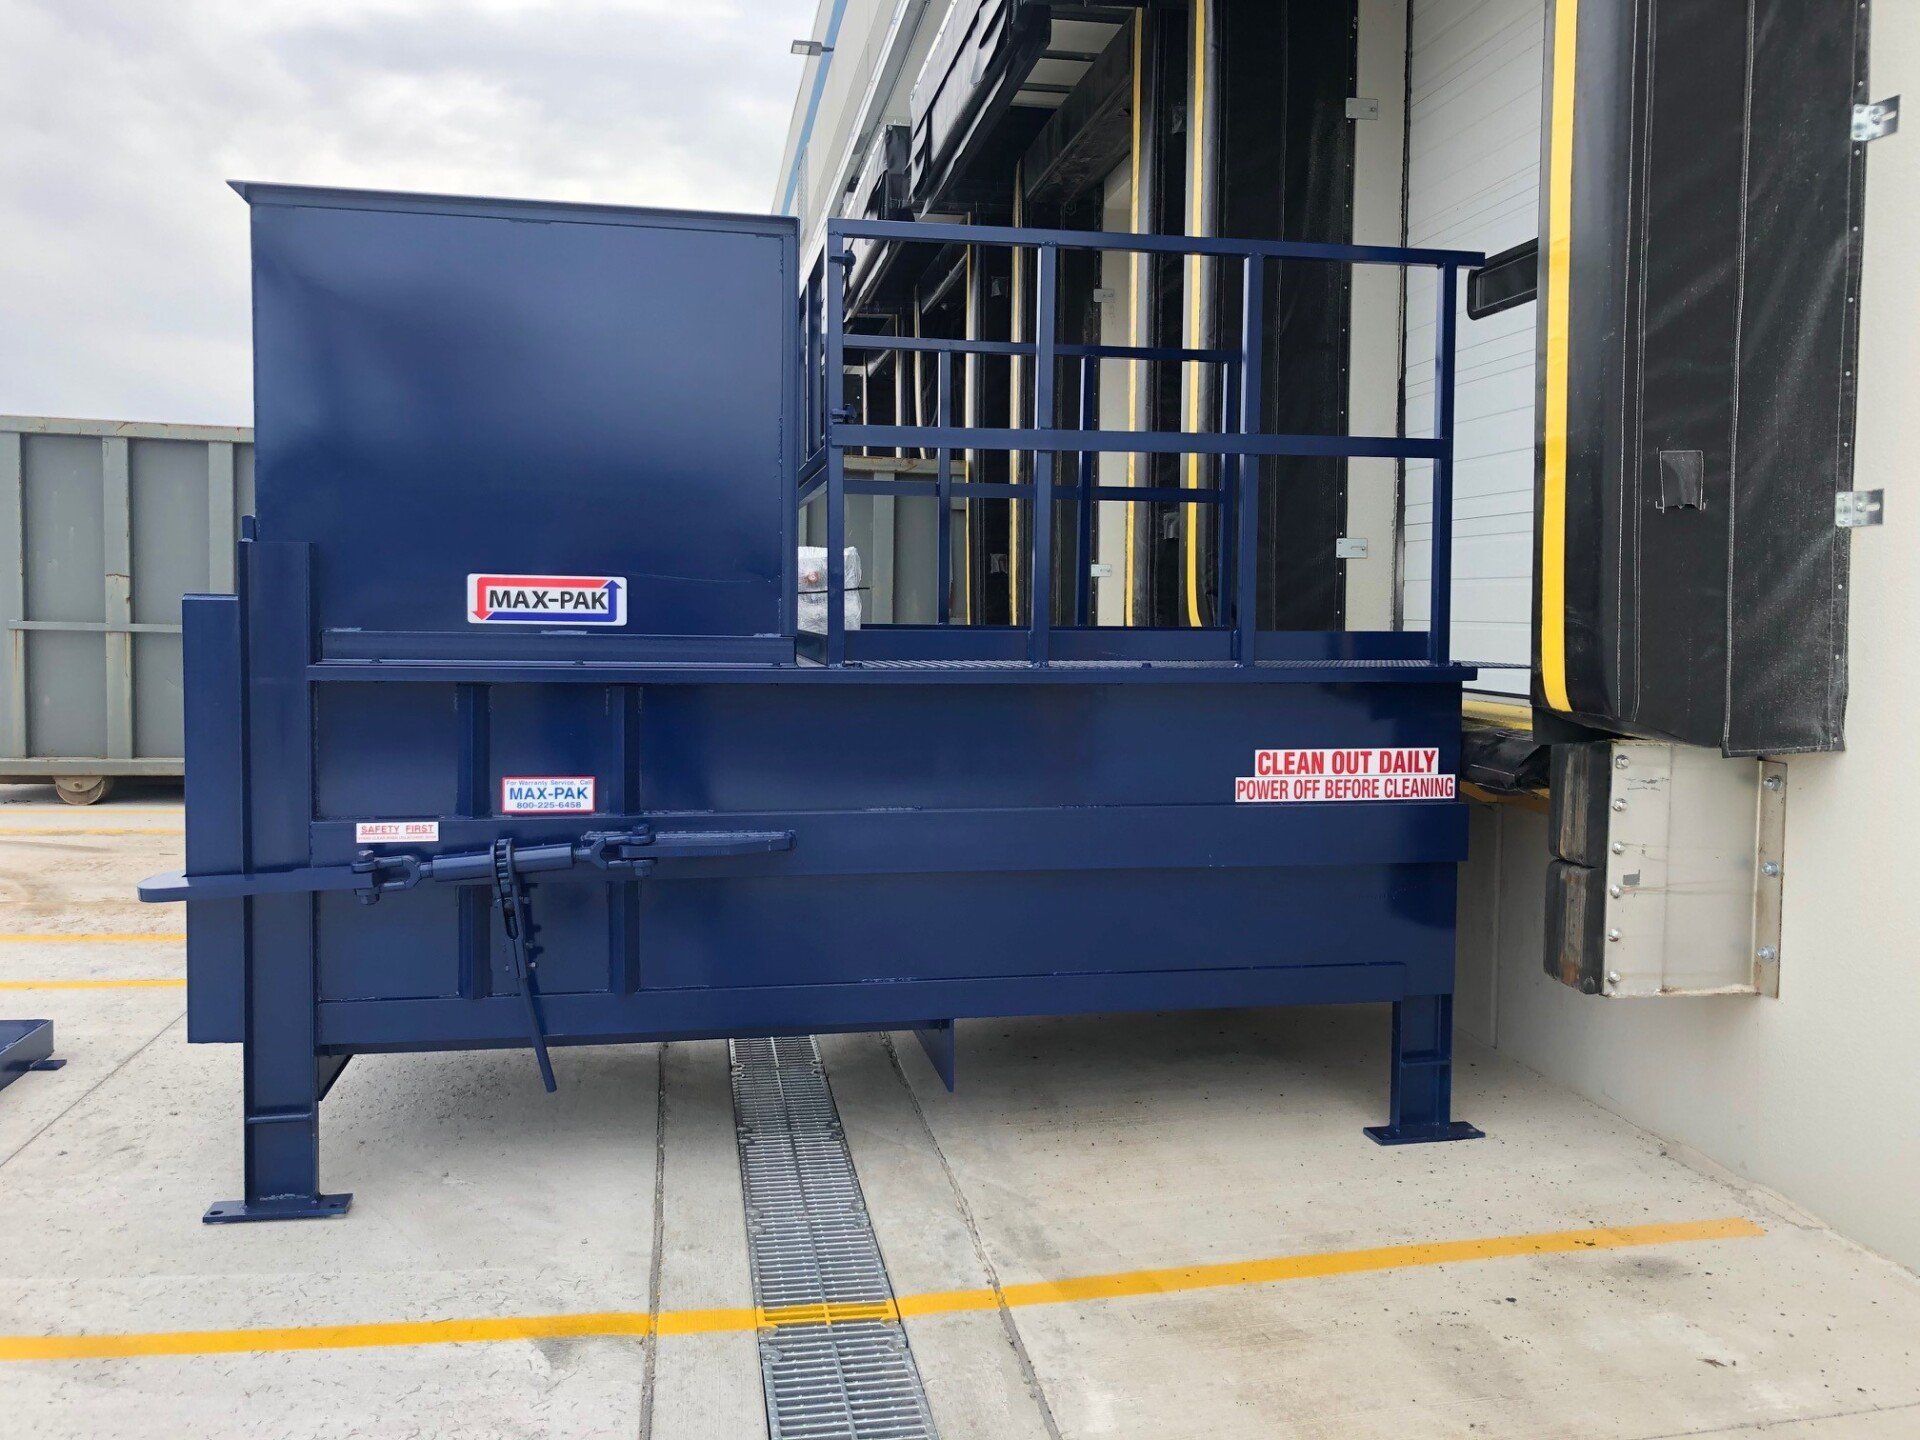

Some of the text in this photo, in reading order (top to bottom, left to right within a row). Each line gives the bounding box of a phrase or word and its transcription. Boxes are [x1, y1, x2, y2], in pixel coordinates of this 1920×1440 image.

[489, 590, 607, 610] MAX-PAK
[1257, 750, 1436, 775] CLEAN OUT DAILY
[509, 787, 588, 800] MAX-PAK
[1237, 777, 1454, 800] POWER OFF BEFORE CLEANING
[361, 825, 434, 834] SAFETY FIRST
